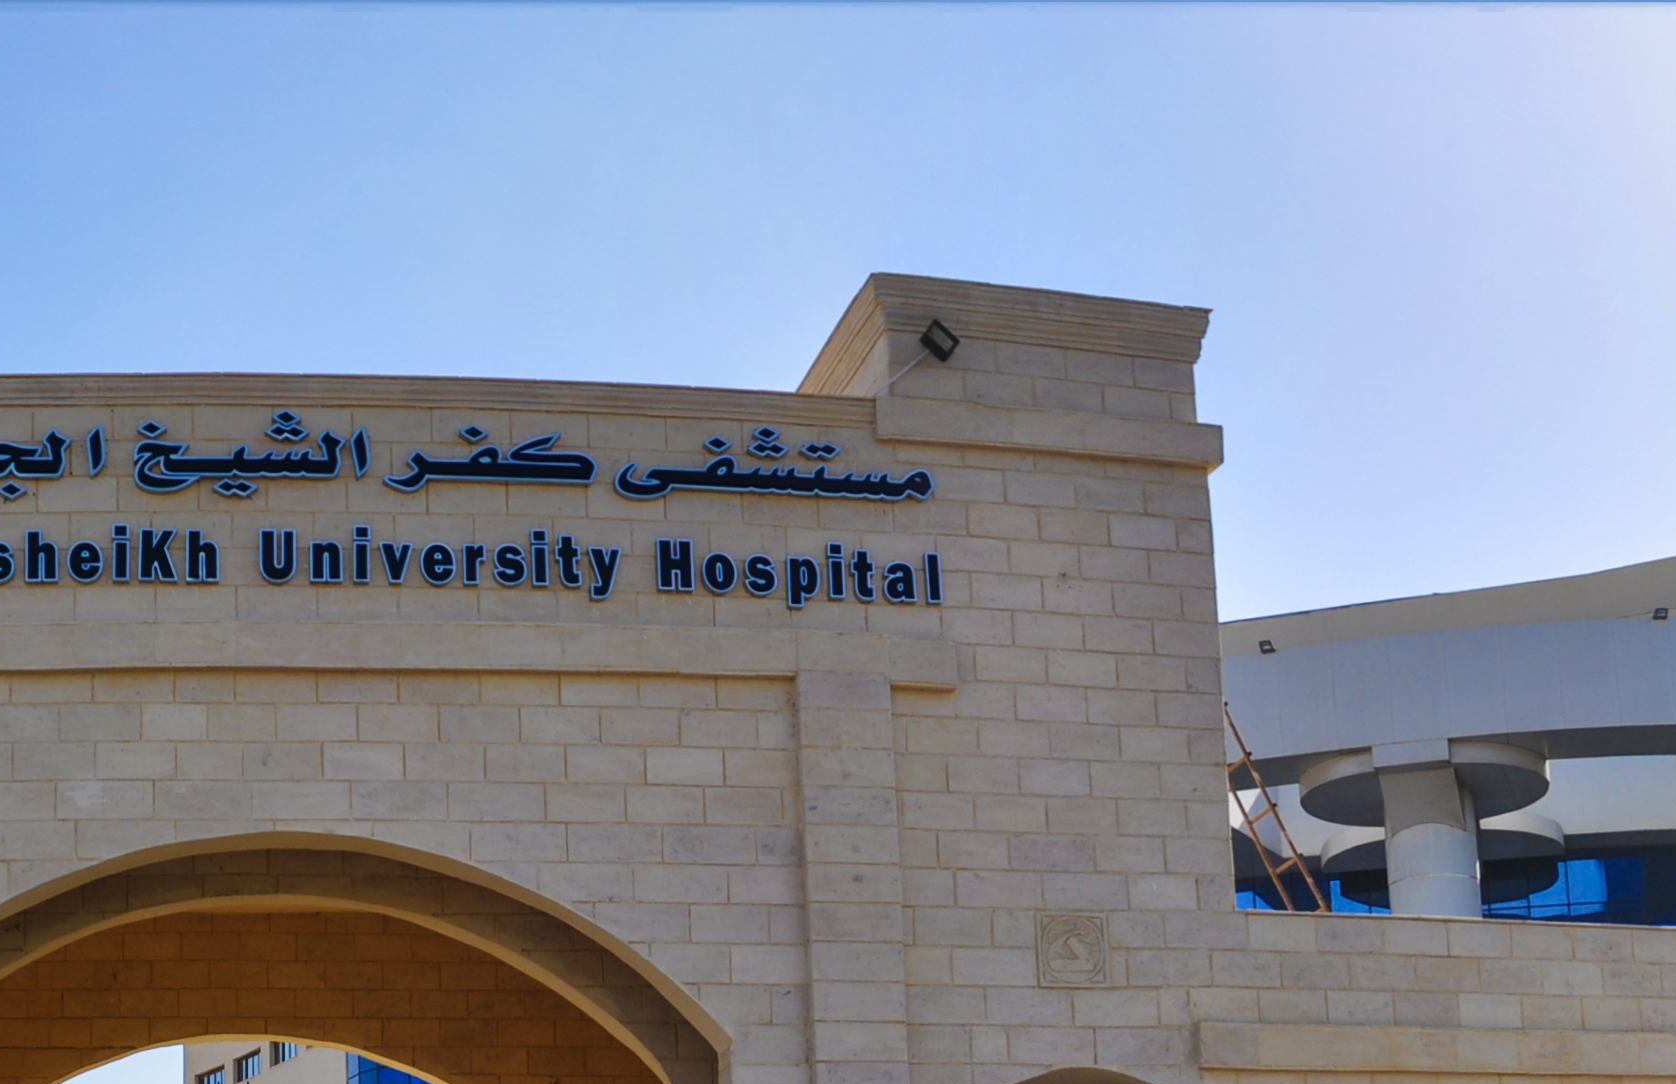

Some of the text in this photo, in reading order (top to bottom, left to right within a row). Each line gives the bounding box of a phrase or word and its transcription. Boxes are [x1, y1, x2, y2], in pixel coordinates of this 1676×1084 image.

[133, 410, 370, 498] الشيخ
[382, 424, 597, 492] كفر
[615, 425, 935, 500] مستشفى
[259, 524, 622, 600] University
[656, 538, 944, 609] Hospital
